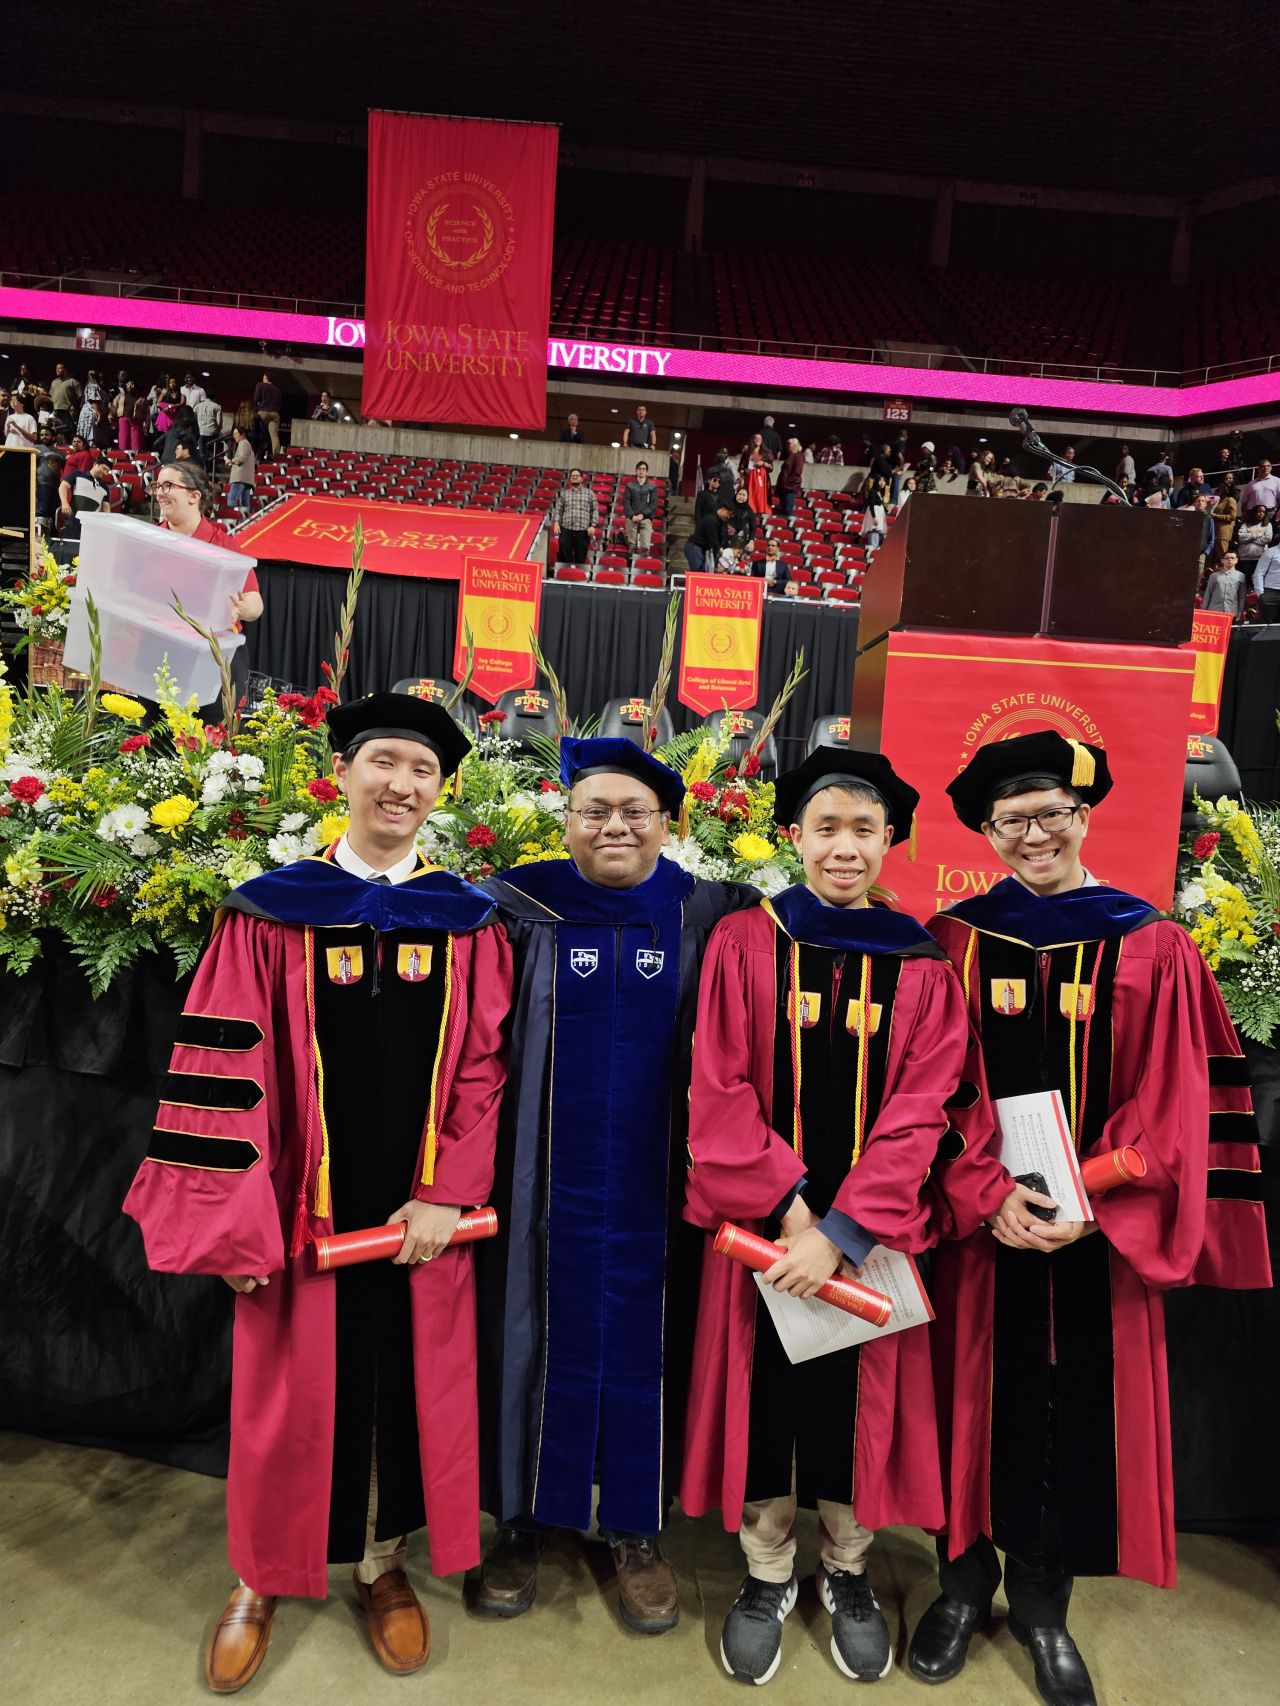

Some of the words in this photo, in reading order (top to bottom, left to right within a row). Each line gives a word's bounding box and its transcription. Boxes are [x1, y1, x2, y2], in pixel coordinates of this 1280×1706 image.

[408, 188, 428, 216] IOWA
[427, 171, 460, 189] STATE
[464, 172, 515, 221] UNIVERSITY
[404, 231, 415, 247] OF
[408, 249, 443, 288] SCIENCE
[466, 238, 516, 293] TECHNOLOGY
[445, 283, 465, 294] AND
[81, 337, 100, 349] 121
[384, 320, 449, 348] IOWA
[458, 324, 528, 352] STATE
[386, 349, 528, 377] UNIVERSITY
[549, 341, 671, 376] IVERSITY
[886, 408, 909, 420] 123
[300, 519, 388, 538] IOWA
[399, 531, 499, 544] STATE
[472, 566, 499, 580] IOWA
[501, 569, 531, 583] STATE
[471, 578, 530, 593] UNIVERSITY
[695, 585, 722, 598] IOWA
[724, 587, 753, 600] STATE
[695, 597, 753, 611] UNIVERSITY
[1192, 621, 1222, 635] STATE
[1191, 632, 1220, 645] RSITY
[485, 665, 513, 673] Business
[490, 658, 512, 667] College
[687, 676, 708, 684] College
[717, 677, 737, 685] Liberal
[407, 685, 444, 698] STATE
[710, 684, 737, 692] Sciences
[514, 696, 549, 709] STATE
[962, 712, 992, 747] IOWA
[991, 693, 1036, 714] STATE
[1186, 741, 1214, 753] TATE
[935, 864, 1008, 893] IOW
